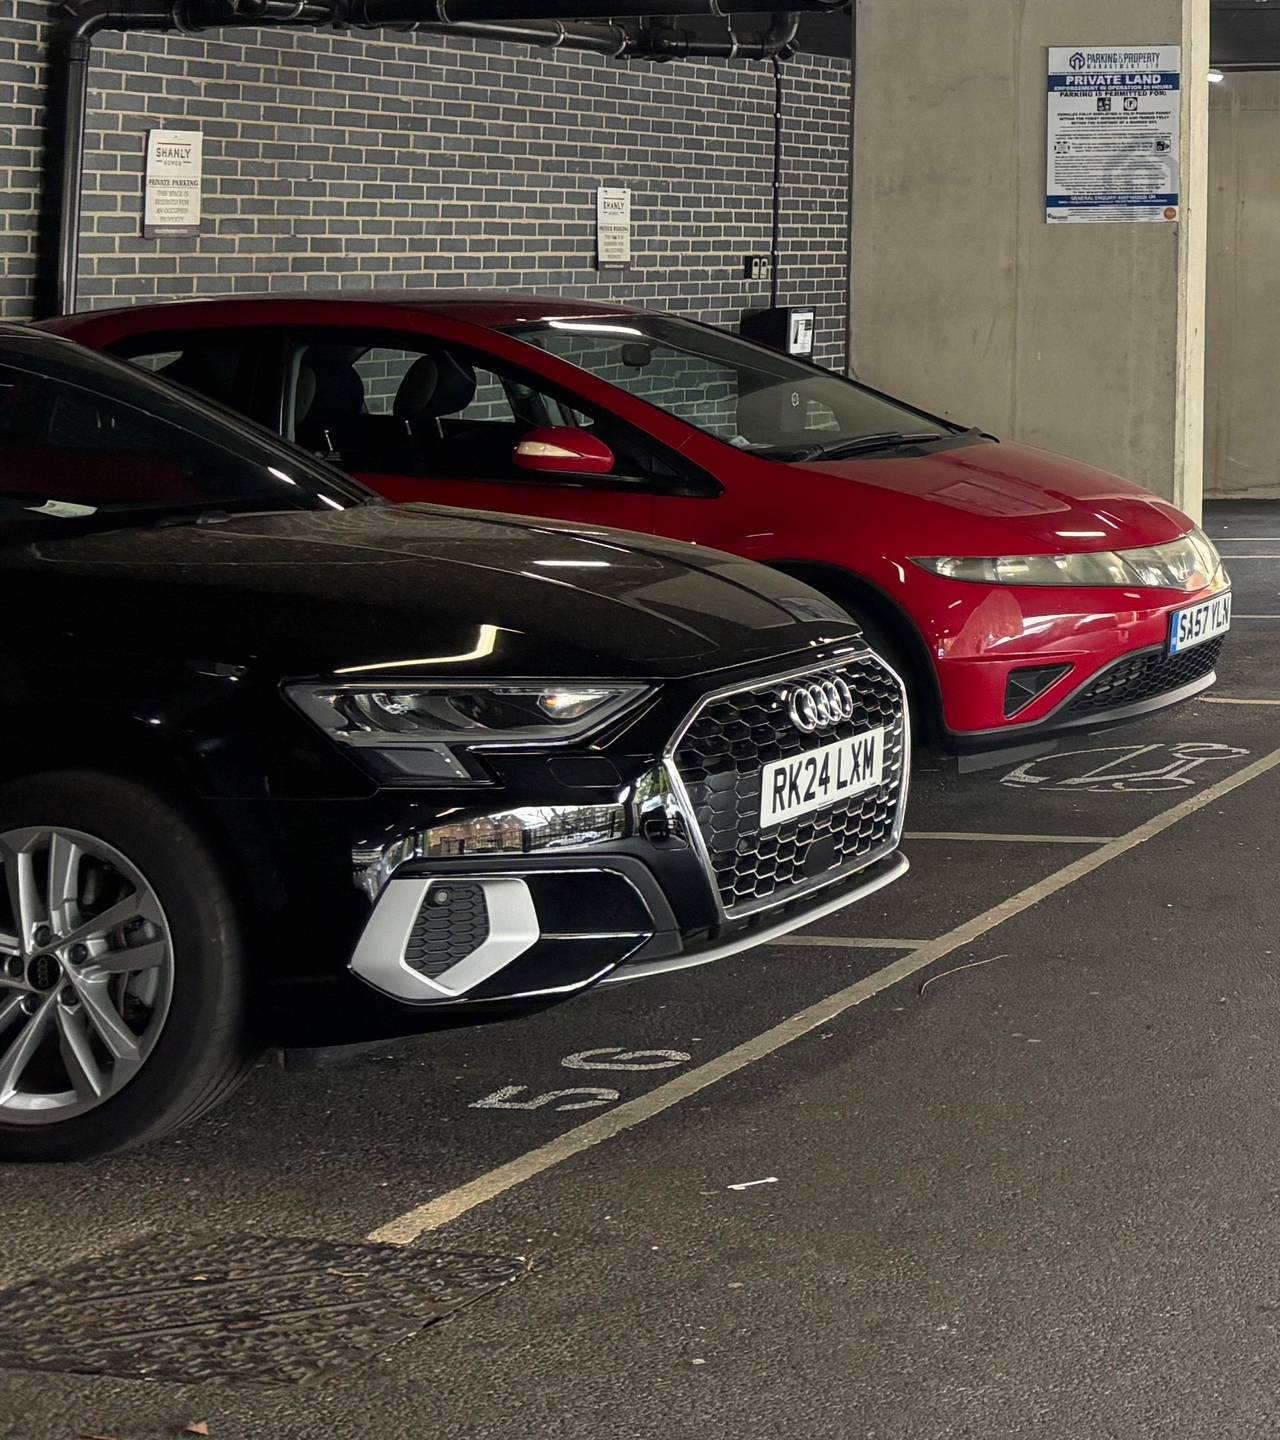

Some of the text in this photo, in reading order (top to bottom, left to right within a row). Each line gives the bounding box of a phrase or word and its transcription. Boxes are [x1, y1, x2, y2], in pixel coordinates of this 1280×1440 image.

[1087, 53, 1117, 64] PARKING
[1123, 52, 1160, 63] PROPERTY
[1065, 74, 1161, 86] PRIVATE LAND
[155, 147, 191, 158] SHANLY
[148, 178, 199, 187] PRIVATE PARKING
[1179, 596, 1230, 643] SA57 YLN
[772, 735, 875, 814] RK24 LXM
[468, 1047, 691, 1111] 56
